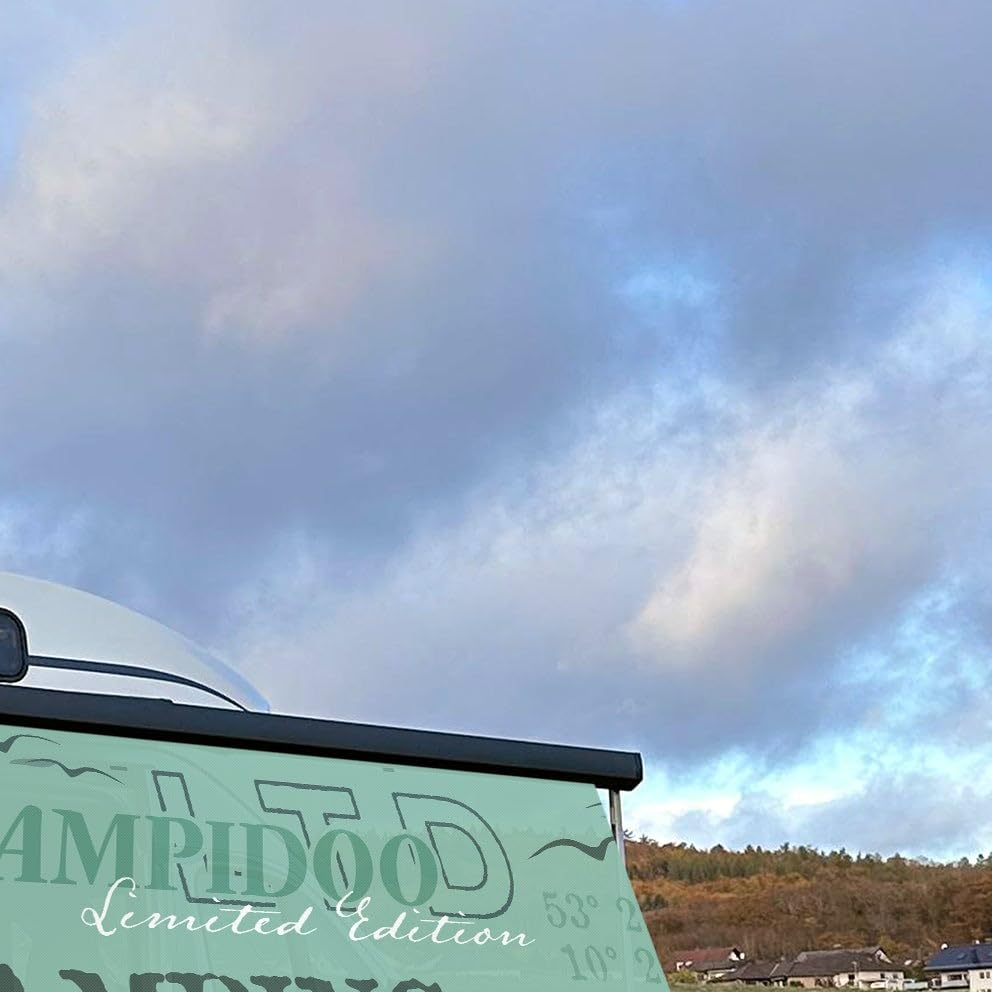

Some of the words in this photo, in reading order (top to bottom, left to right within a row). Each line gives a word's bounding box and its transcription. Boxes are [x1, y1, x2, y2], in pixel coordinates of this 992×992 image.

[151, 769, 515, 920] LTD
[80, 876, 317, 937] Limited
[335, 889, 536, 947] Edition
